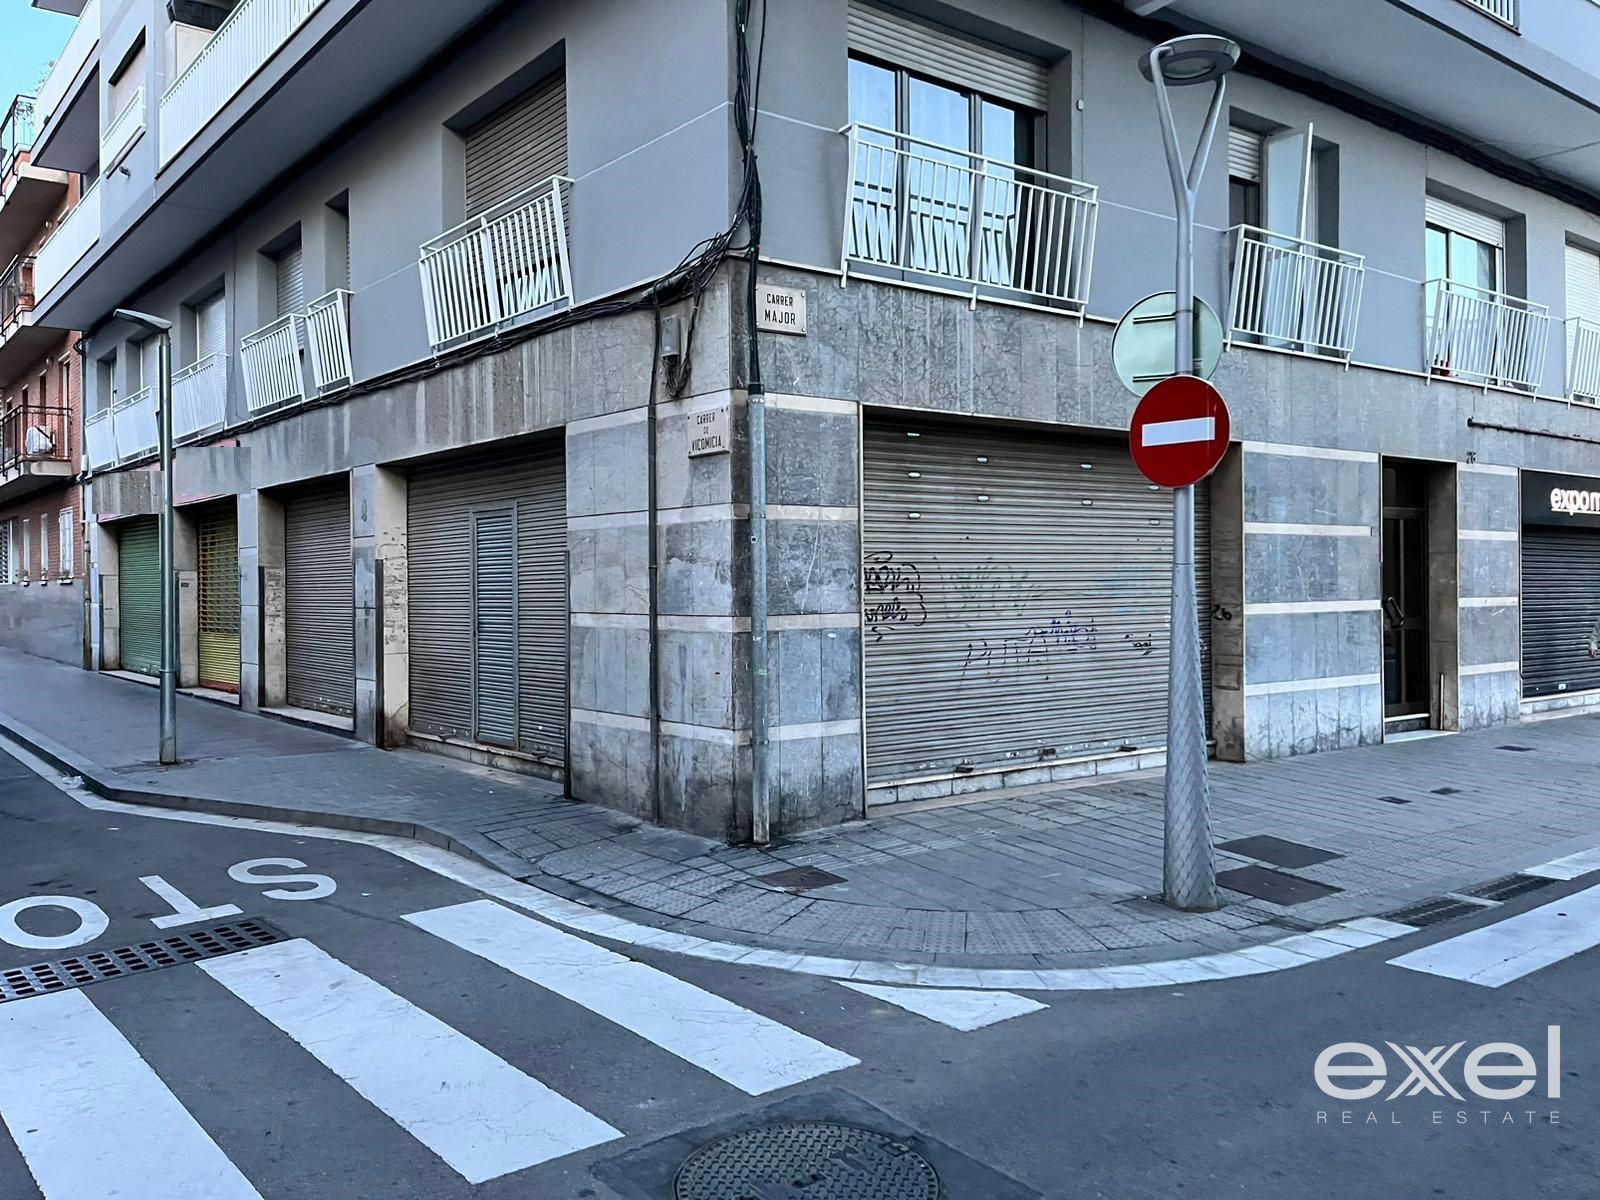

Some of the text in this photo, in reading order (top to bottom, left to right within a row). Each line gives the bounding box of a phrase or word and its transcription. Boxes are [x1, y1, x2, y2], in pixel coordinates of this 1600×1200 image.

[766, 293, 794, 307] CARRER
[764, 309, 796, 326] MAJOR
[696, 411, 715, 425] CARRER
